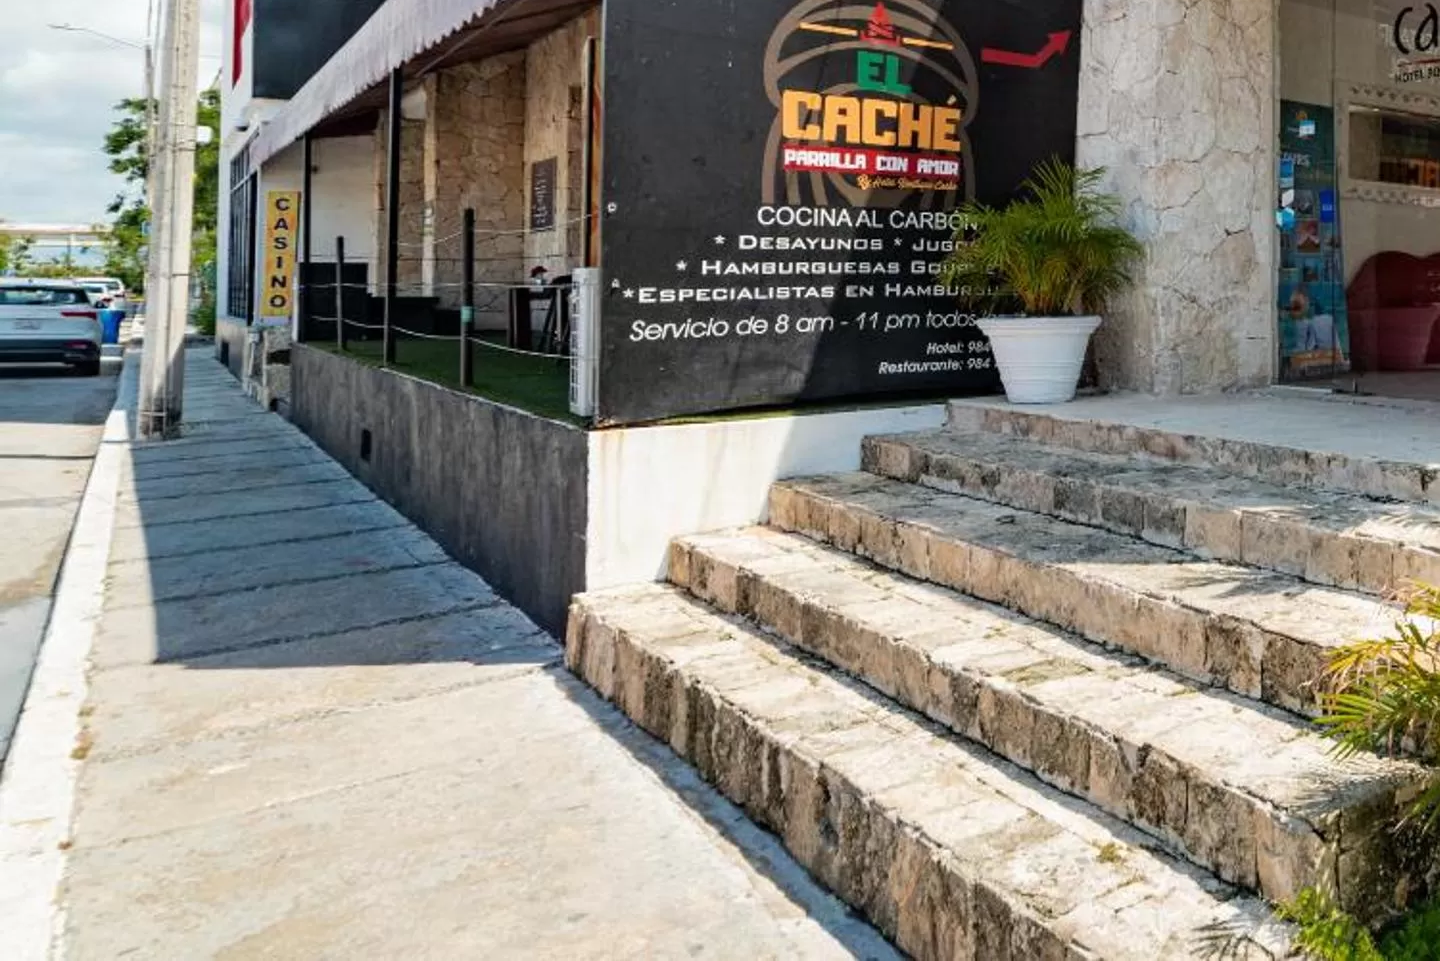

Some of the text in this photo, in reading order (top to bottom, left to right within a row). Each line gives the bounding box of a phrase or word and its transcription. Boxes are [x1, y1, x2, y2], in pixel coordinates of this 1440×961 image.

[857, 50, 913, 95] EL
[1394, 67, 1425, 84] HOTEL
[782, 89, 961, 153] CACHÉ
[784, 148, 959, 176] PARRILLA CON AMOR
[757, 206, 852, 228] COCINA
[856, 210, 884, 229] AL
[269, 198, 291, 308] CASINO
[738, 235, 883, 251] DESAYUNOS
[701, 259, 900, 275] HAMBURGUESAS
[638, 286, 836, 304] ESPECIALISTAS
[846, 285, 875, 298] EN
[629, 317, 730, 342] Servicio
[736, 316, 769, 335] de
[775, 314, 790, 334] 8
[796, 316, 834, 333] am
[856, 311, 880, 331] 11
[884, 313, 920, 333] pm
[926, 309, 978, 329] todos
[926, 341, 963, 355] Hotel:
[878, 358, 991, 375] Restaurante: 984
